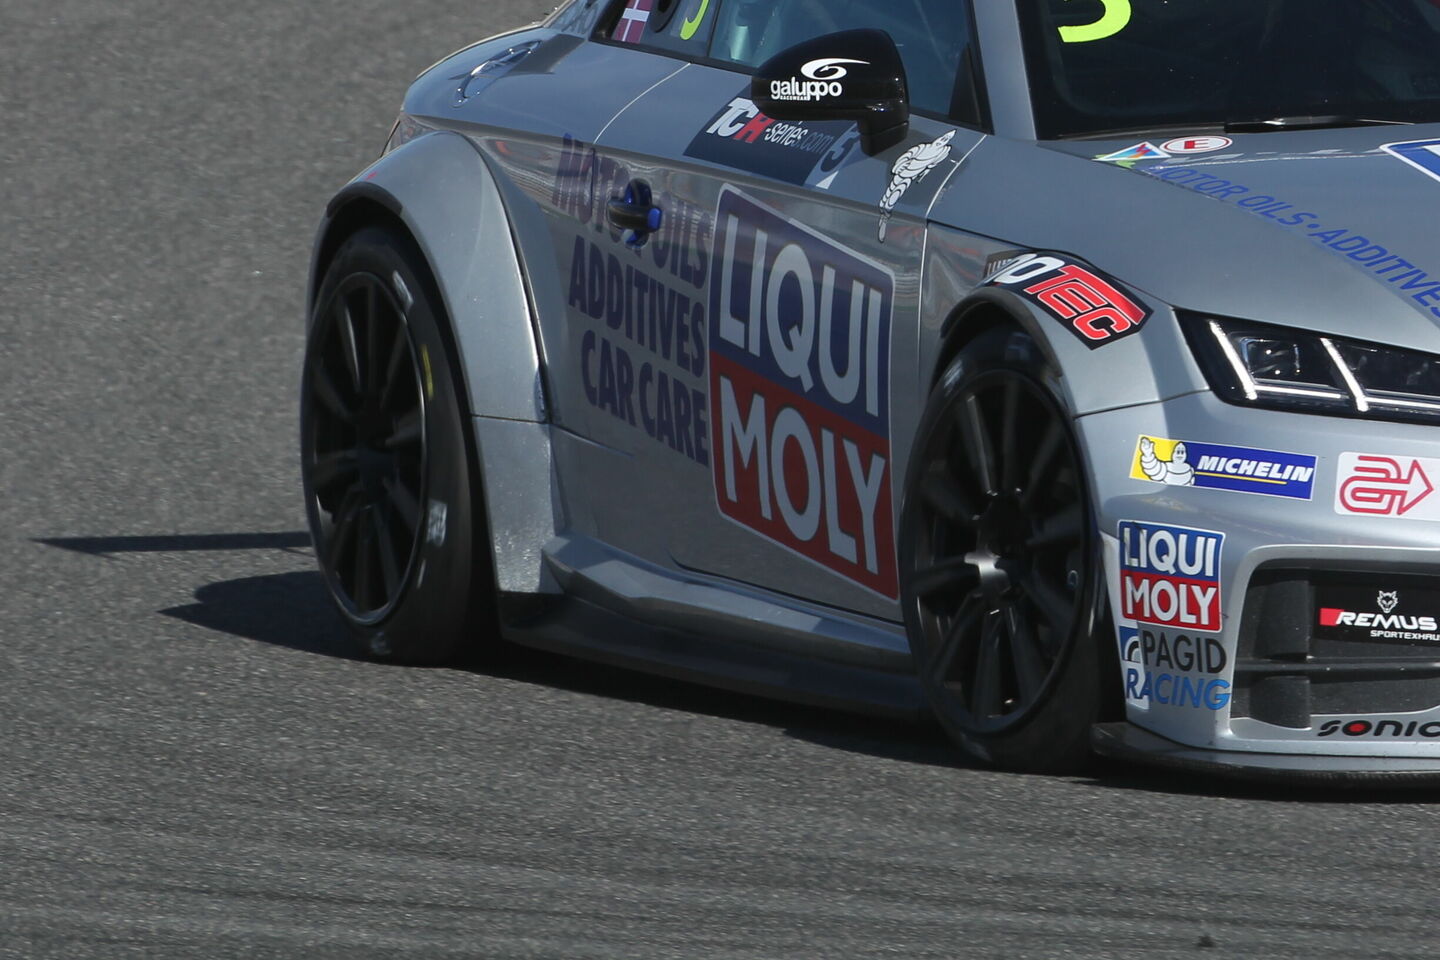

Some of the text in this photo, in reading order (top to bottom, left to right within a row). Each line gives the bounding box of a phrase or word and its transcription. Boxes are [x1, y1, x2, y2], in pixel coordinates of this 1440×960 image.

[770, 76, 843, 102] galuppo
[1237, 194, 1312, 226] OILS
[568, 233, 706, 378] ADDITIVES
[719, 212, 883, 418] LIQUI
[581, 329, 709, 468] CAR CARE
[719, 374, 886, 576] MOLY
[1196, 454, 1314, 484] MICHELIN
[1123, 526, 1219, 577] LIQUI
[1125, 574, 1218, 626] MOLY
[1335, 611, 1438, 632] REMUS
[1141, 629, 1228, 675] PAGID
[1125, 668, 1231, 711] RACING
